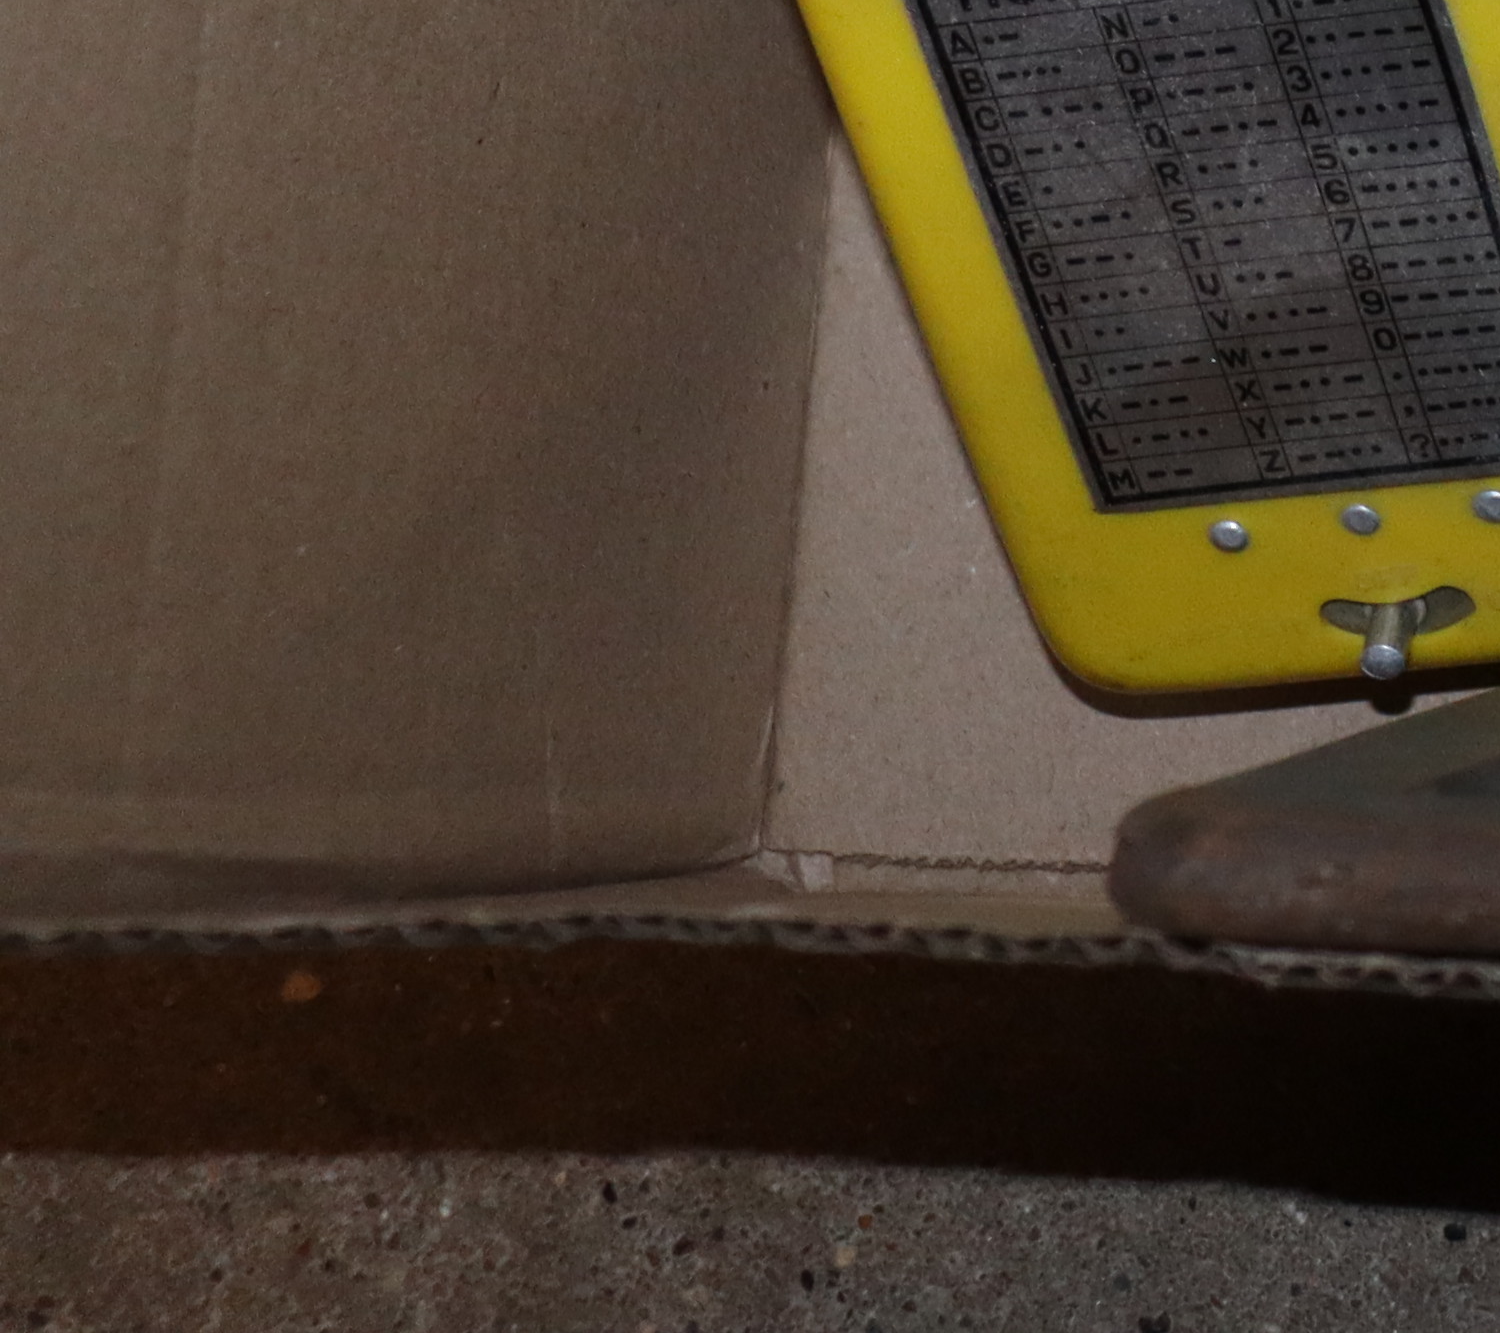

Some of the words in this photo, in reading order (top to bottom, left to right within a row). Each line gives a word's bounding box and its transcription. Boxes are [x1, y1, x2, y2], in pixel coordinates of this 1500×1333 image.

[951, 30, 974, 54] A
[1101, 13, 1129, 39] N
[959, 68, 985, 94] B
[1273, 29, 1298, 55] 2
[975, 105, 999, 131] C
[1130, 87, 1154, 113] P
[1287, 65, 1313, 92] 3
[986, 144, 1012, 168] D
[1144, 123, 1171, 148] Q
[1301, 104, 1320, 128] 4
[1002, 182, 1027, 206] E
[1157, 162, 1183, 187] R
[1311, 144, 1338, 169] 5
[1015, 220, 1035, 242] F
[1171, 200, 1195, 224] S
[1324, 180, 1349, 203] 6
[1027, 251, 1051, 277] G
[1181, 237, 1201, 260] T
[1335, 217, 1355, 242] 7
[1040, 293, 1068, 315] H
[1196, 273, 1220, 296] U
[1348, 254, 1374, 281] 8
[1060, 329, 1072, 349] I
[1208, 309, 1228, 331] V
[1360, 290, 1384, 314] 9
[1076, 364, 1092, 385] J
[1219, 347, 1247, 368] W
[1080, 398, 1107, 421] K
[1235, 380, 1261, 402] X
[1097, 433, 1118, 456] L
[1247, 417, 1266, 439] Y
[1108, 469, 1136, 490] M
[1260, 450, 1285, 472] Z
[1410, 434, 1429, 457] ?
